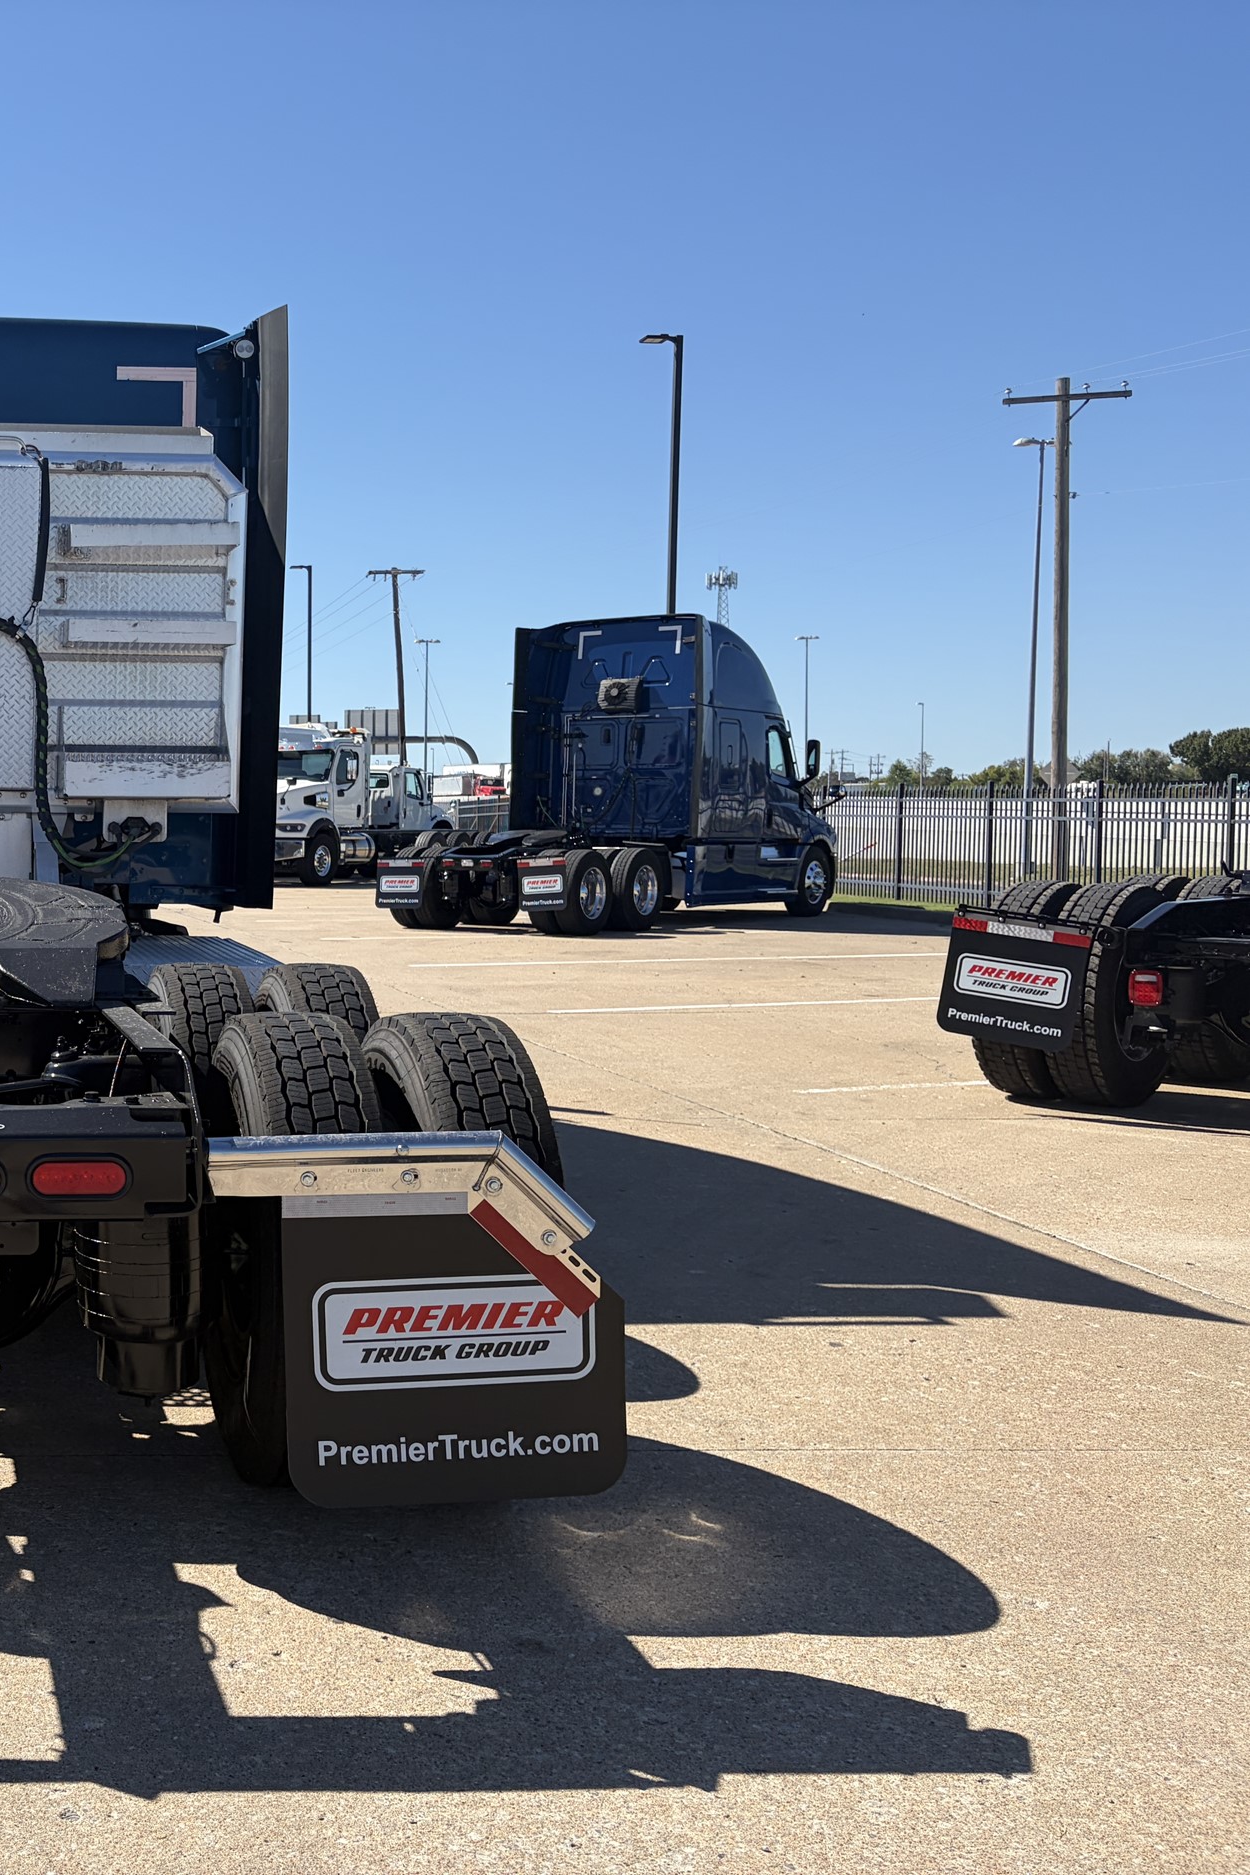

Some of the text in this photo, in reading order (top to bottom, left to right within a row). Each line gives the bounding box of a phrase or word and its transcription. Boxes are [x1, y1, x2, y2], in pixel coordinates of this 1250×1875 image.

[968, 964, 1059, 987] PREMIER
[971, 979, 1049, 997] TRUCK GROUP
[947, 1007, 1062, 1037] PremierTruck.com
[342, 1300, 565, 1336] PREMIER
[360, 1339, 551, 1364] TRUCK GROUP
[317, 1430, 599, 1467] PremierTruck.com
